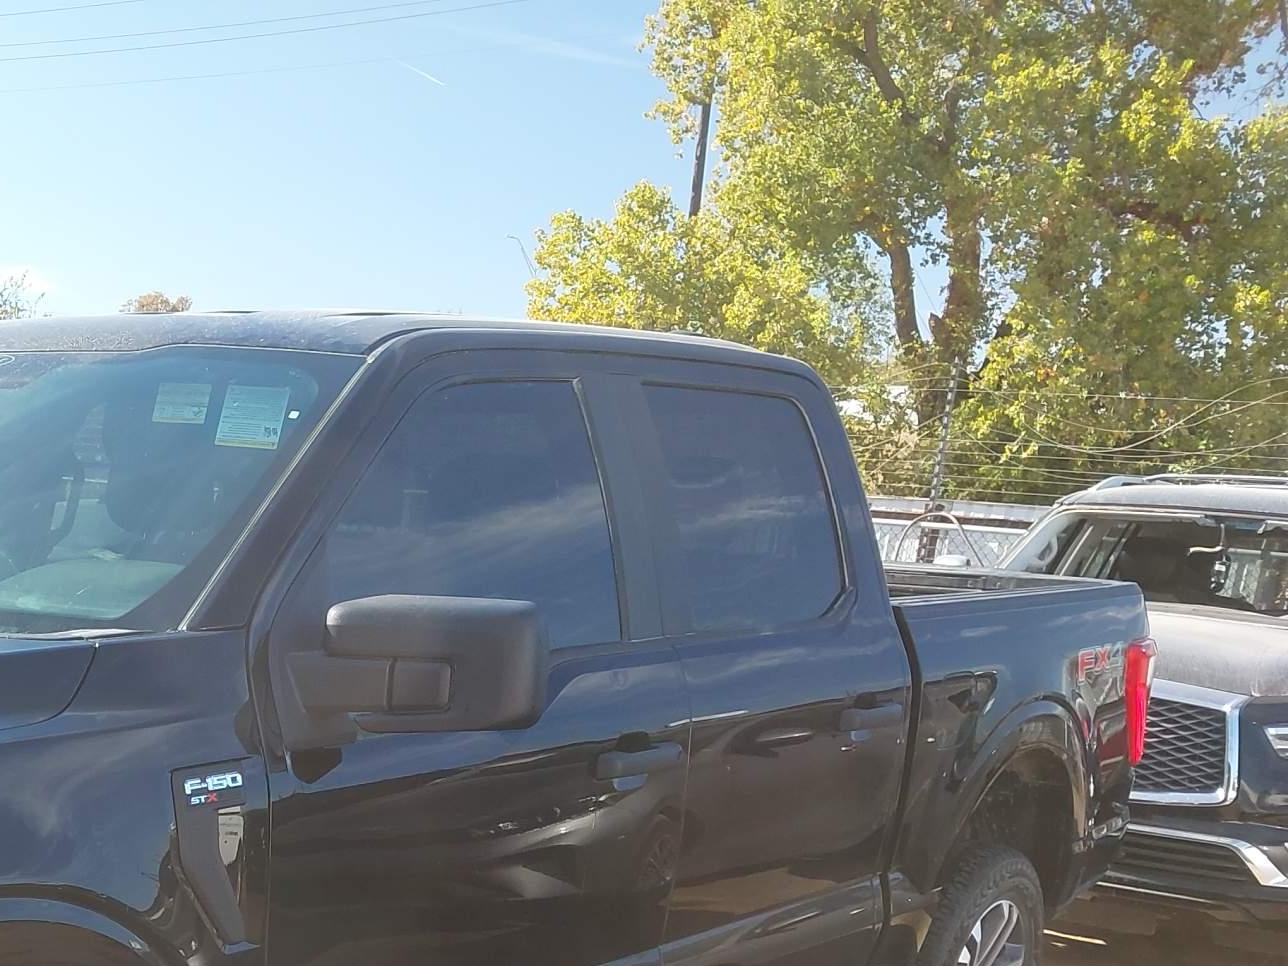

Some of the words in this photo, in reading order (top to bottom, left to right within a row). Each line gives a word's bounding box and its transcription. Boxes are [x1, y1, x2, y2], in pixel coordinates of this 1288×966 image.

[1077, 641, 1124, 684] FX4
[184, 771, 243, 795] F-150
[191, 792, 217, 805] STX
